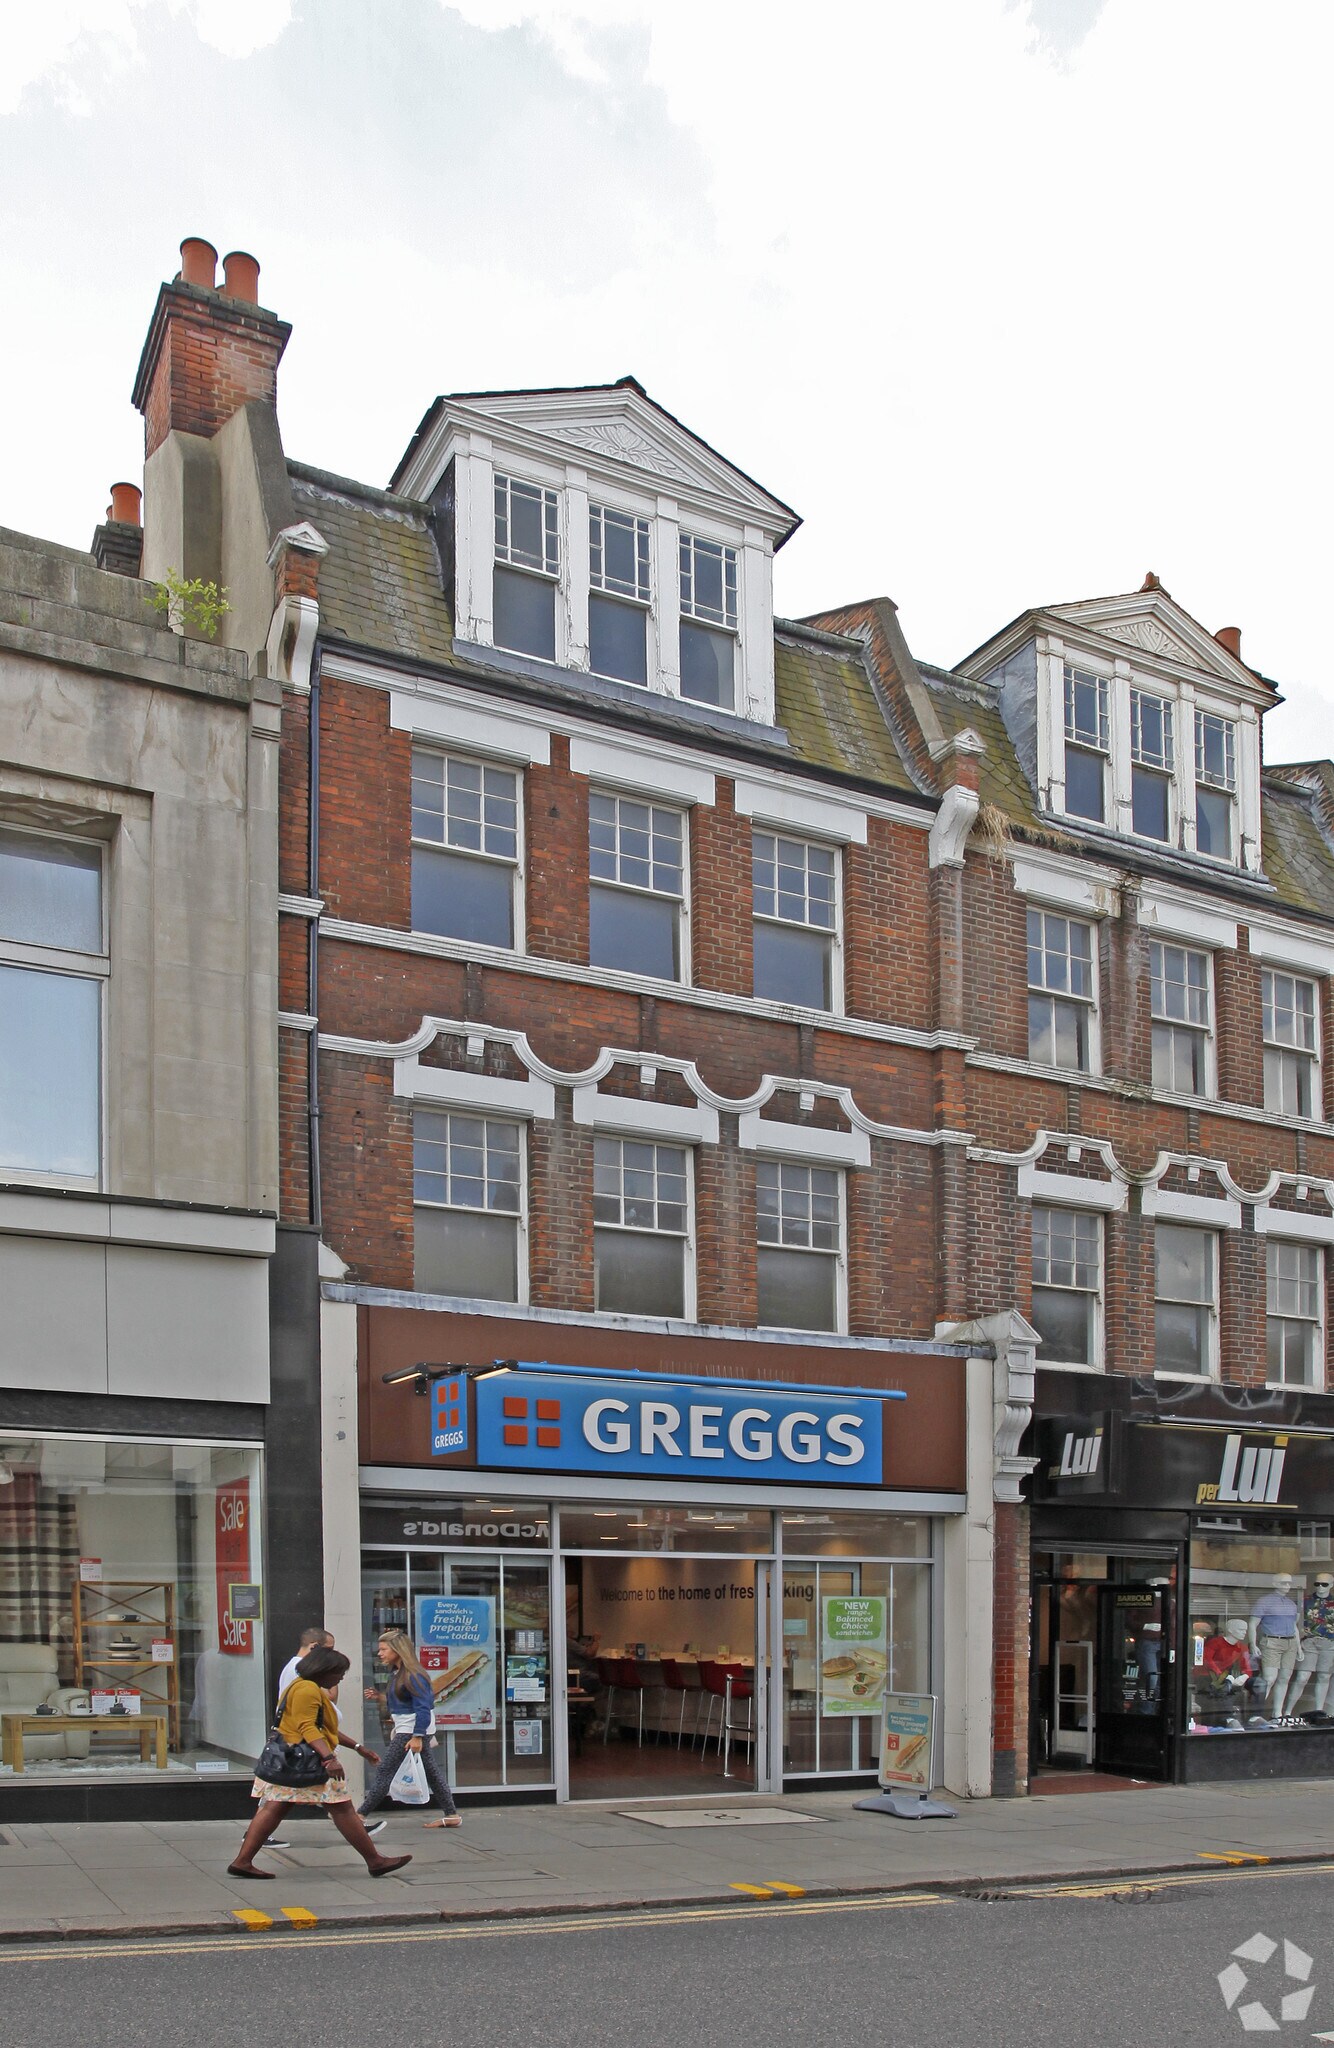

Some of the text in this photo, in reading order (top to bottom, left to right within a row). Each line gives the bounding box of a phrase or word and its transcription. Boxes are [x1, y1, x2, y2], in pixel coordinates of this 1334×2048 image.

[582, 1398, 866, 1466] GREGGS
[434, 1430, 464, 1449] GREGGS
[1059, 1428, 1104, 1476] Lui
[1195, 1434, 1288, 1505] per Lui
[220, 1490, 244, 1532] Sale
[600, 1582, 814, 1602] Welcome to the home of fres king
[1117, 1594, 1152, 1602] BARBOUR
[437, 1601, 458, 1609] Every
[844, 1601, 870, 1610] NEW
[433, 1614, 473, 1625] freshly
[835, 1615, 874, 1623] Balanced
[223, 1610, 247, 1646] Sale
[429, 1624, 478, 1633] prepared
[841, 1622, 869, 1630] Choice
[451, 1632, 480, 1641] today
[427, 1657, 441, 1667] £3
